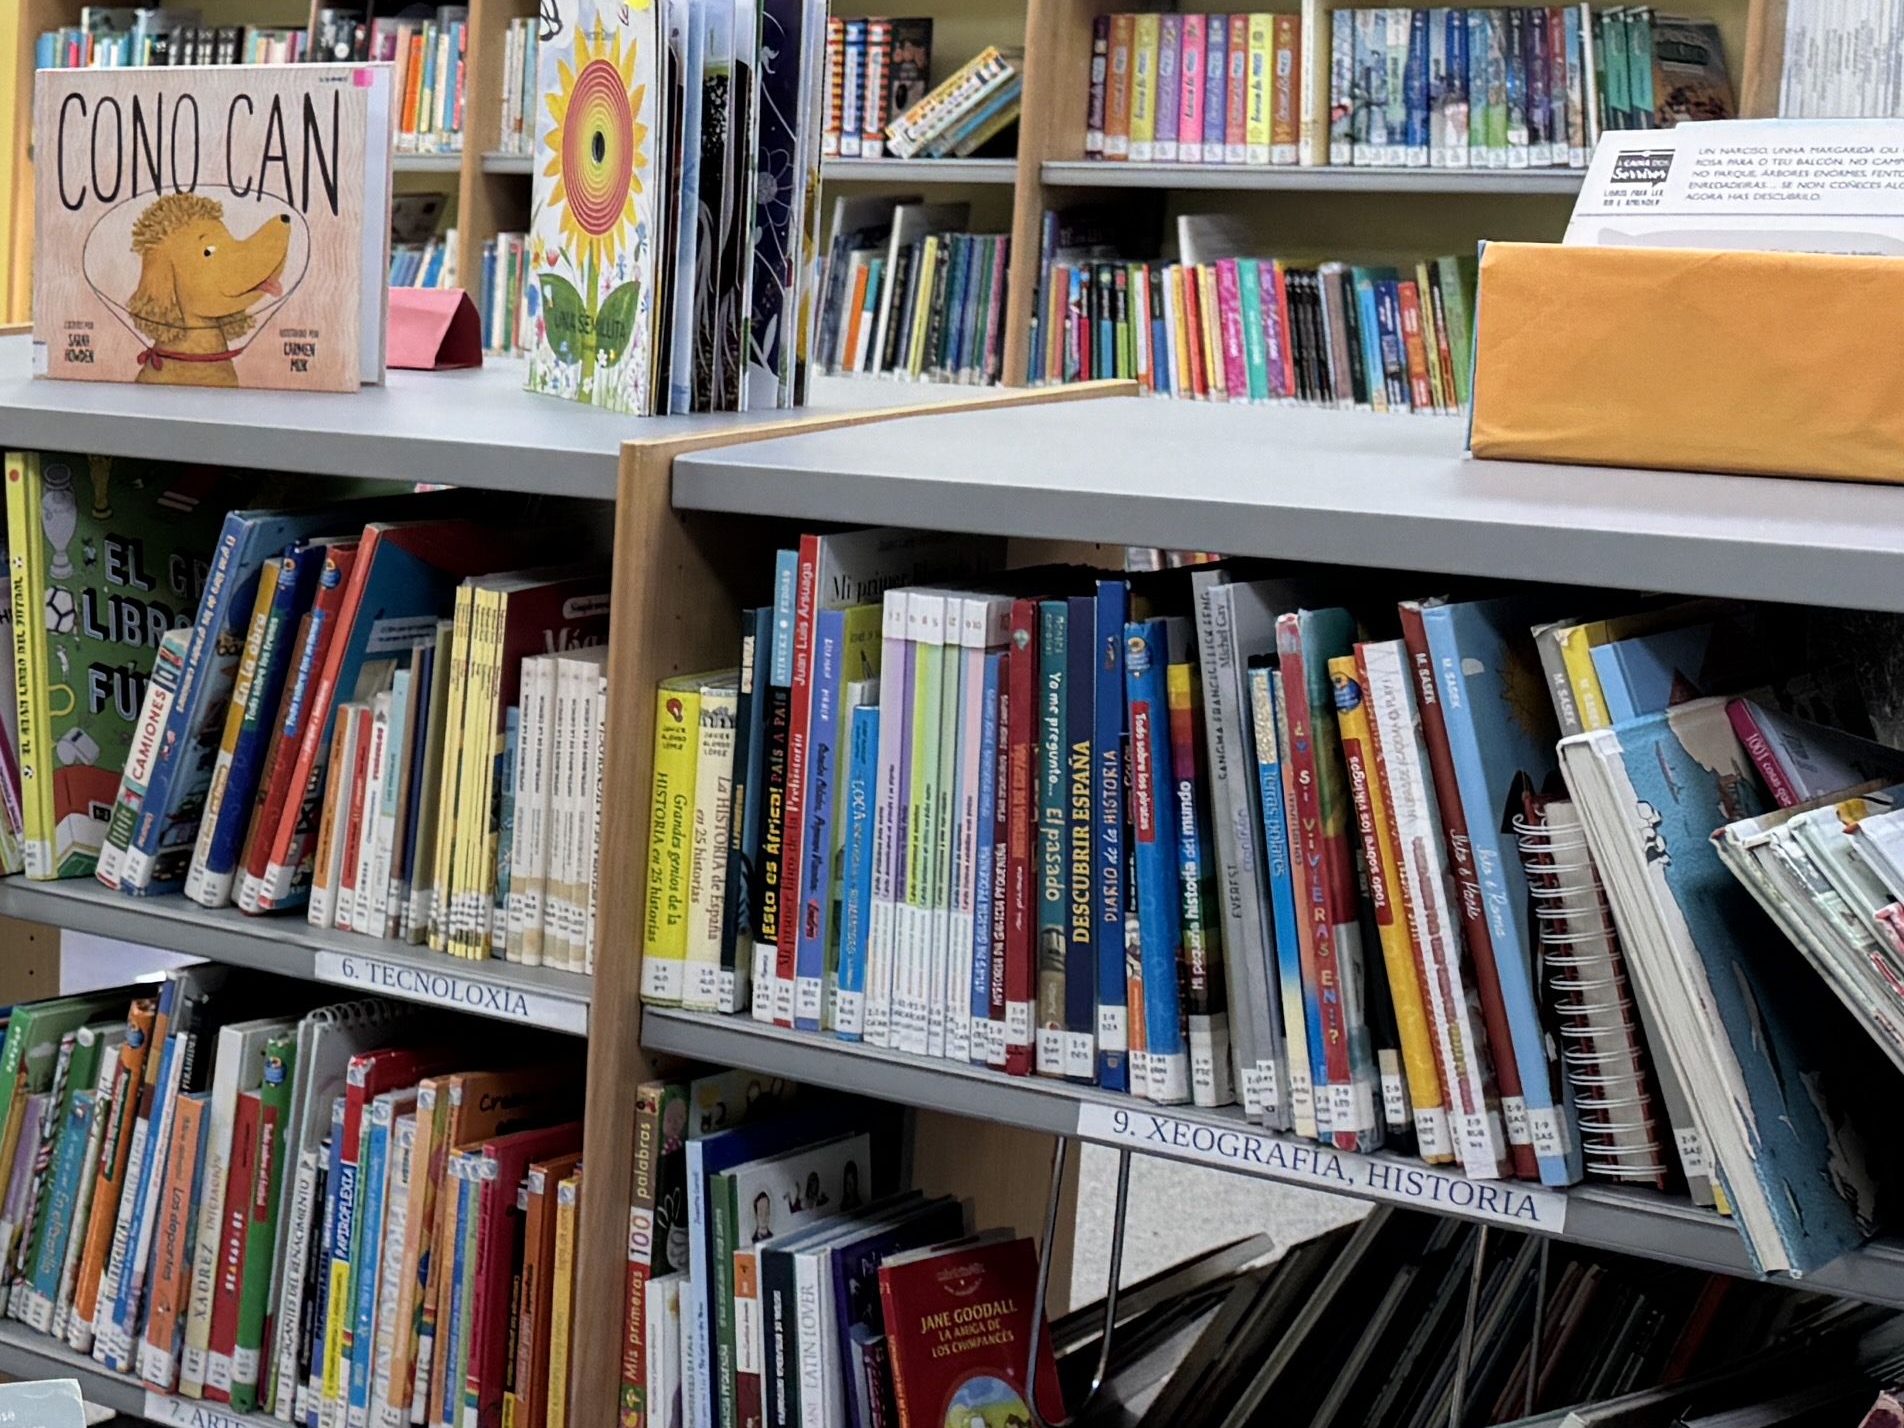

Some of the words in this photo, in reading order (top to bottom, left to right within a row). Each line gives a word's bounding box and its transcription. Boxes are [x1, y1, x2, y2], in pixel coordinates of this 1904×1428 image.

[57, 91, 200, 211] CONO
[228, 89, 340, 217] CAN
[131, 690, 168, 782] CAMIONES
[1070, 740, 1090, 820] ESPAÑA
[1103, 750, 1117, 824] HISTORIA
[1044, 828, 1066, 902] pasado
[1072, 824, 1089, 944] DESCUBRIR
[1104, 869, 1117, 922] DIARIO
[342, 959, 358, 979] 6.
[363, 961, 530, 1017] TECNOLOXÍA
[635, 1122, 651, 1199] palabras
[1112, 1110, 1133, 1135] 9.
[1366, 1161, 1539, 1222] HISTORIA
[629, 1215, 649, 1257] 100
[921, 1315, 951, 1335] JANE
[956, 1299, 1017, 1328] GOODALL
[170, 1399, 186, 1415] 7.
